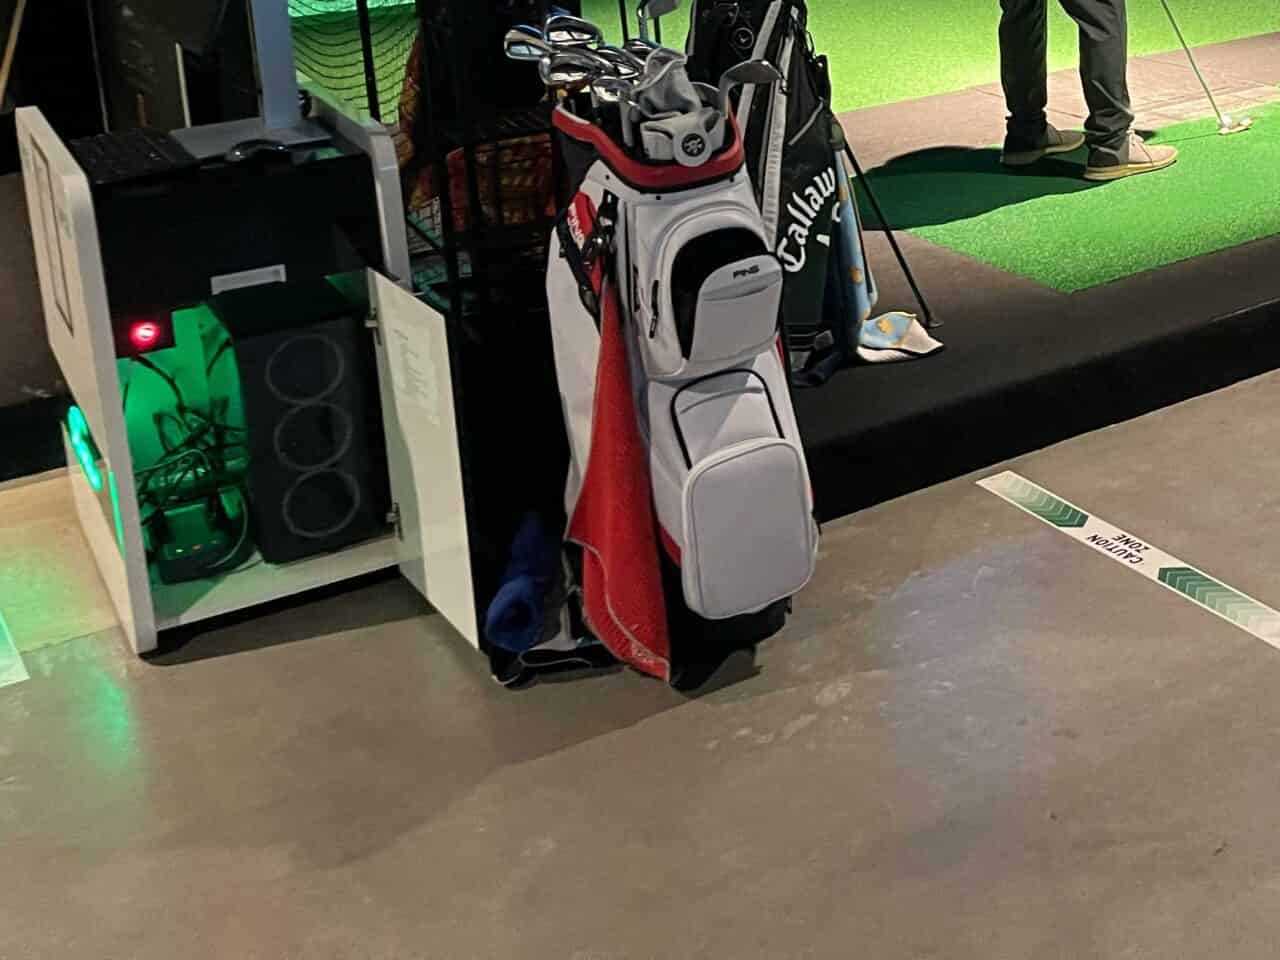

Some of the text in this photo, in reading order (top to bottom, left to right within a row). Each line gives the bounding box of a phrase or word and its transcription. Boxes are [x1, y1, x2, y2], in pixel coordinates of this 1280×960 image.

[776, 167, 836, 272] Callaw
[1087, 534, 1144, 565] CAUTION
[1111, 534, 1150, 553] ZONE
